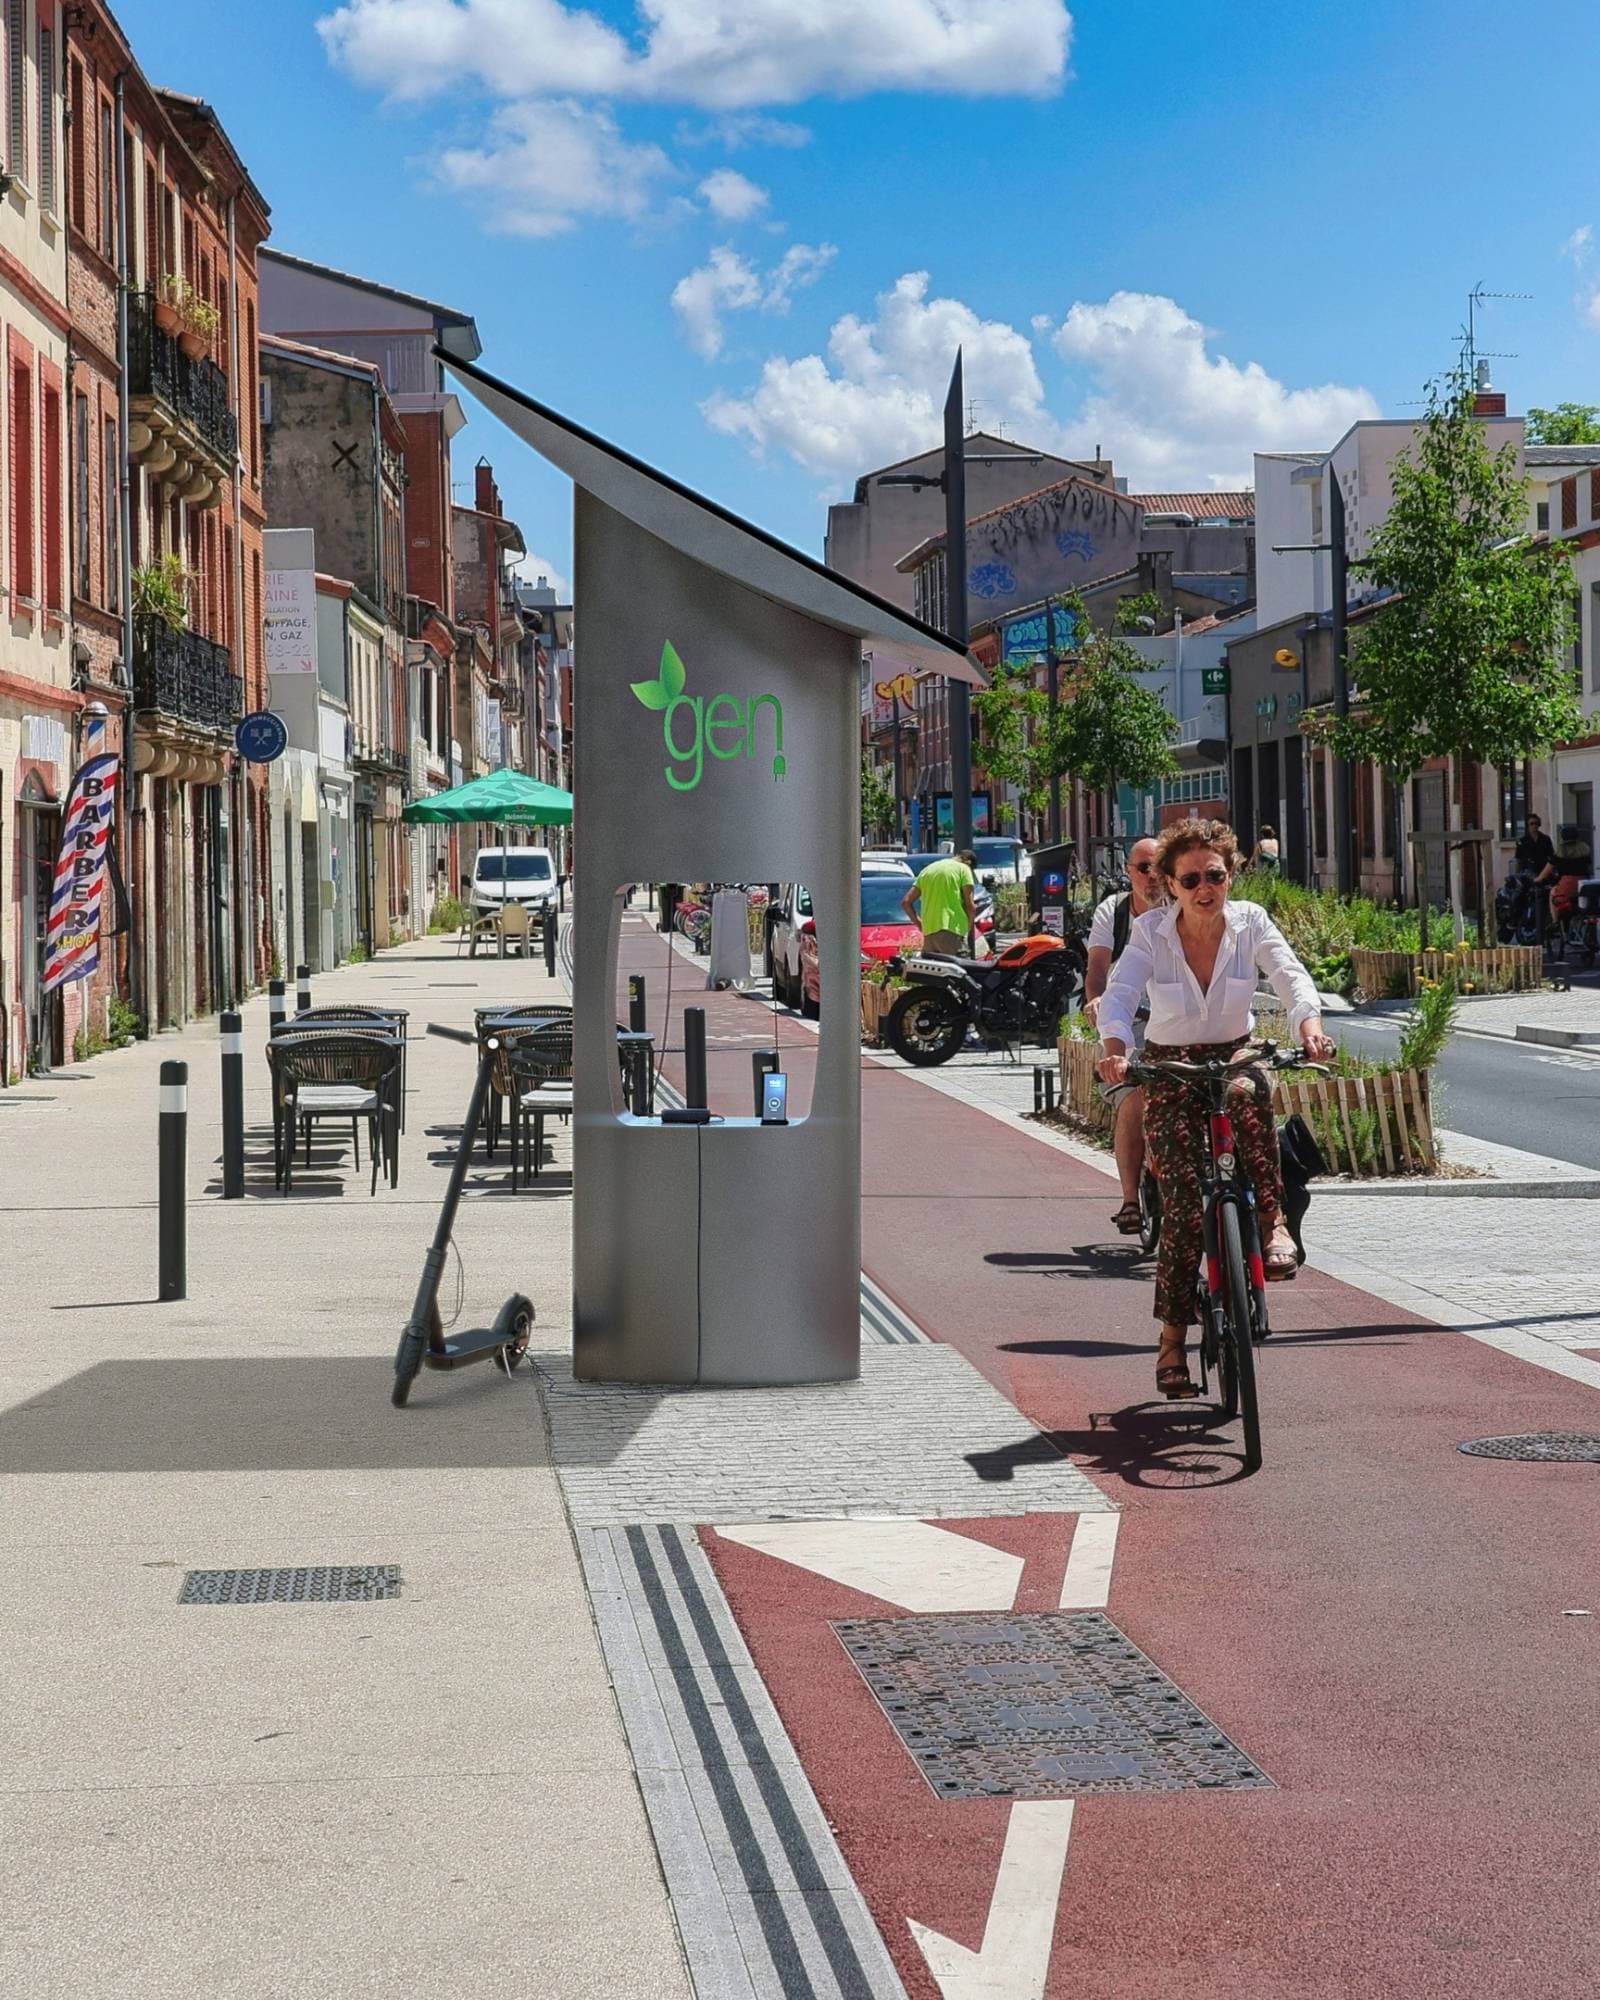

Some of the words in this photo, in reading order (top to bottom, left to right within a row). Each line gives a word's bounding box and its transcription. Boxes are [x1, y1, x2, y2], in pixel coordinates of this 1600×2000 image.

[280, 631, 303, 641] GAZ
[663, 693, 784, 791] gen
[64, 777, 104, 930] BARBER
[1049, 874, 1058, 886] P
[55, 933, 94, 951] SHOP
